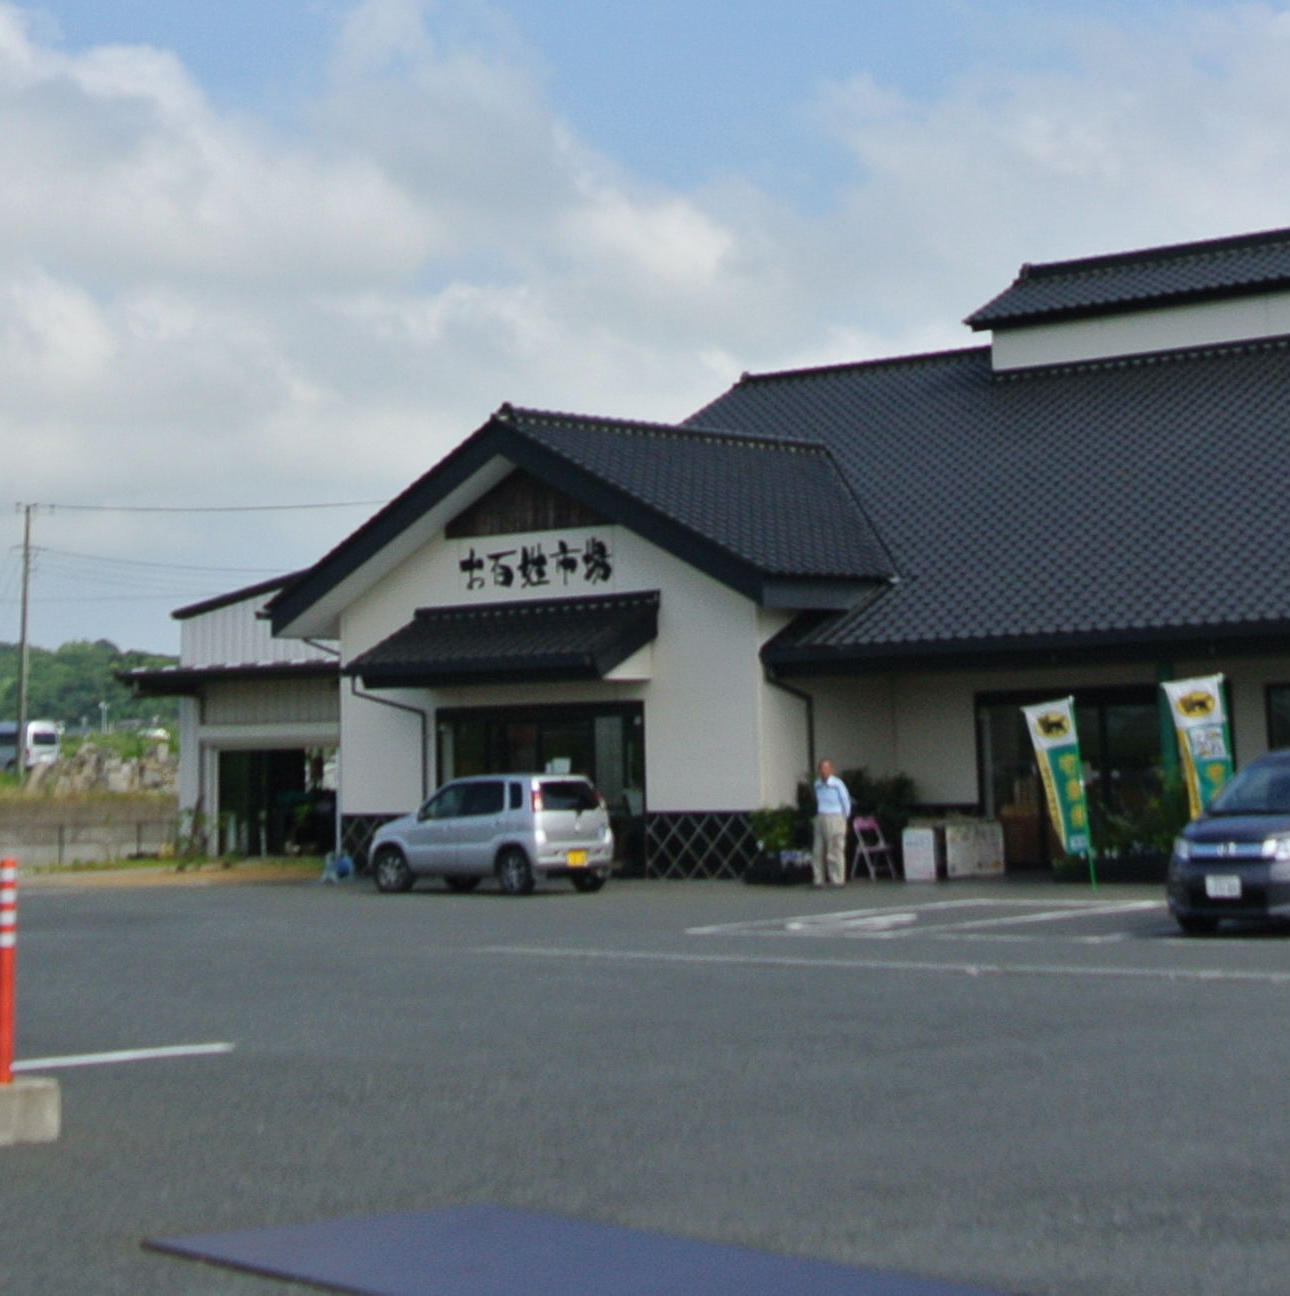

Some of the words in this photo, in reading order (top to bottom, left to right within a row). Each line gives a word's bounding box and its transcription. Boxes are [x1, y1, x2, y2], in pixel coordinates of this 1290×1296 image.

[459, 536, 612, 590] お百姓市場
